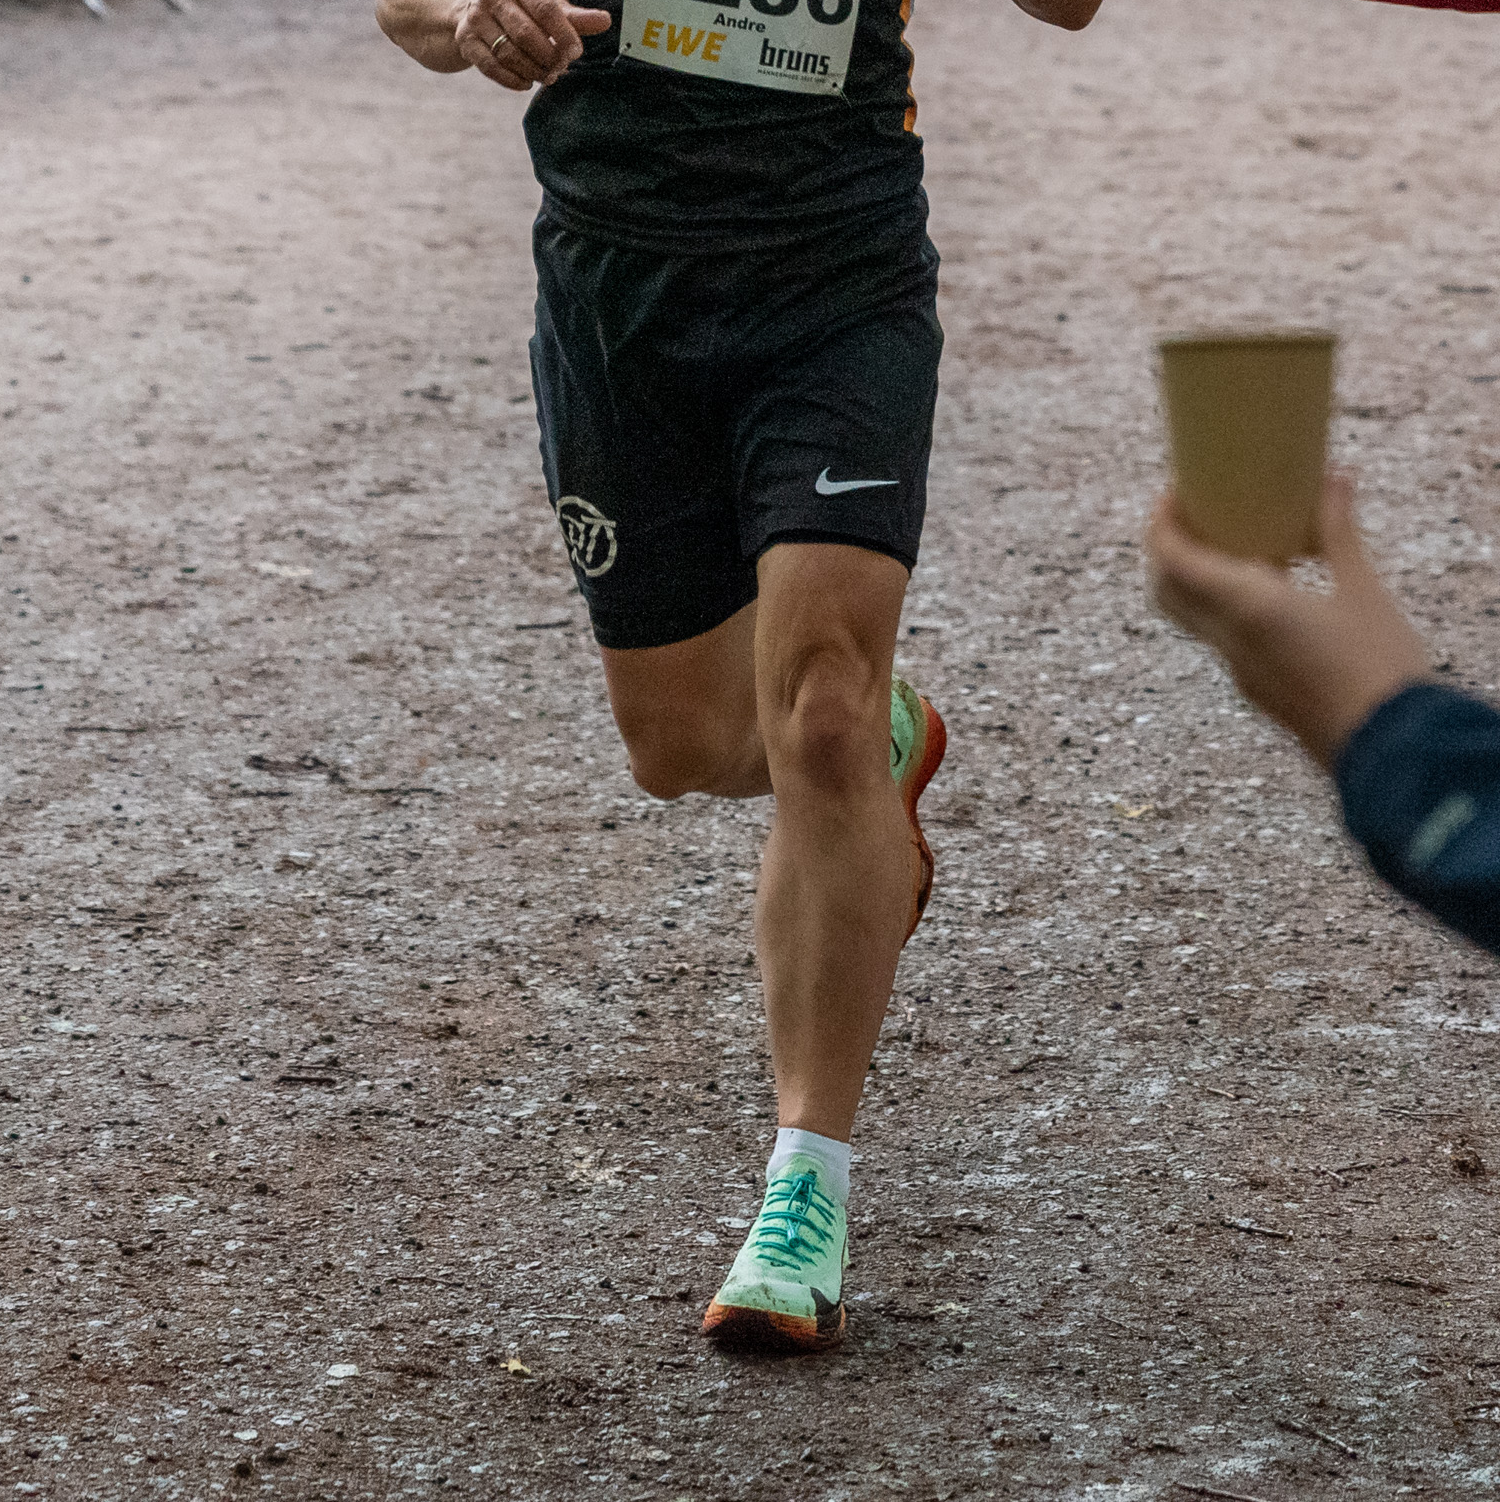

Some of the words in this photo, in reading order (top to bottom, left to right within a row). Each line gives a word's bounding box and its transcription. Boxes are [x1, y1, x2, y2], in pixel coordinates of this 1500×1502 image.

[641, 18, 728, 62] EWE
[713, 13, 766, 33] Andre
[759, 38, 830, 75] bruns
